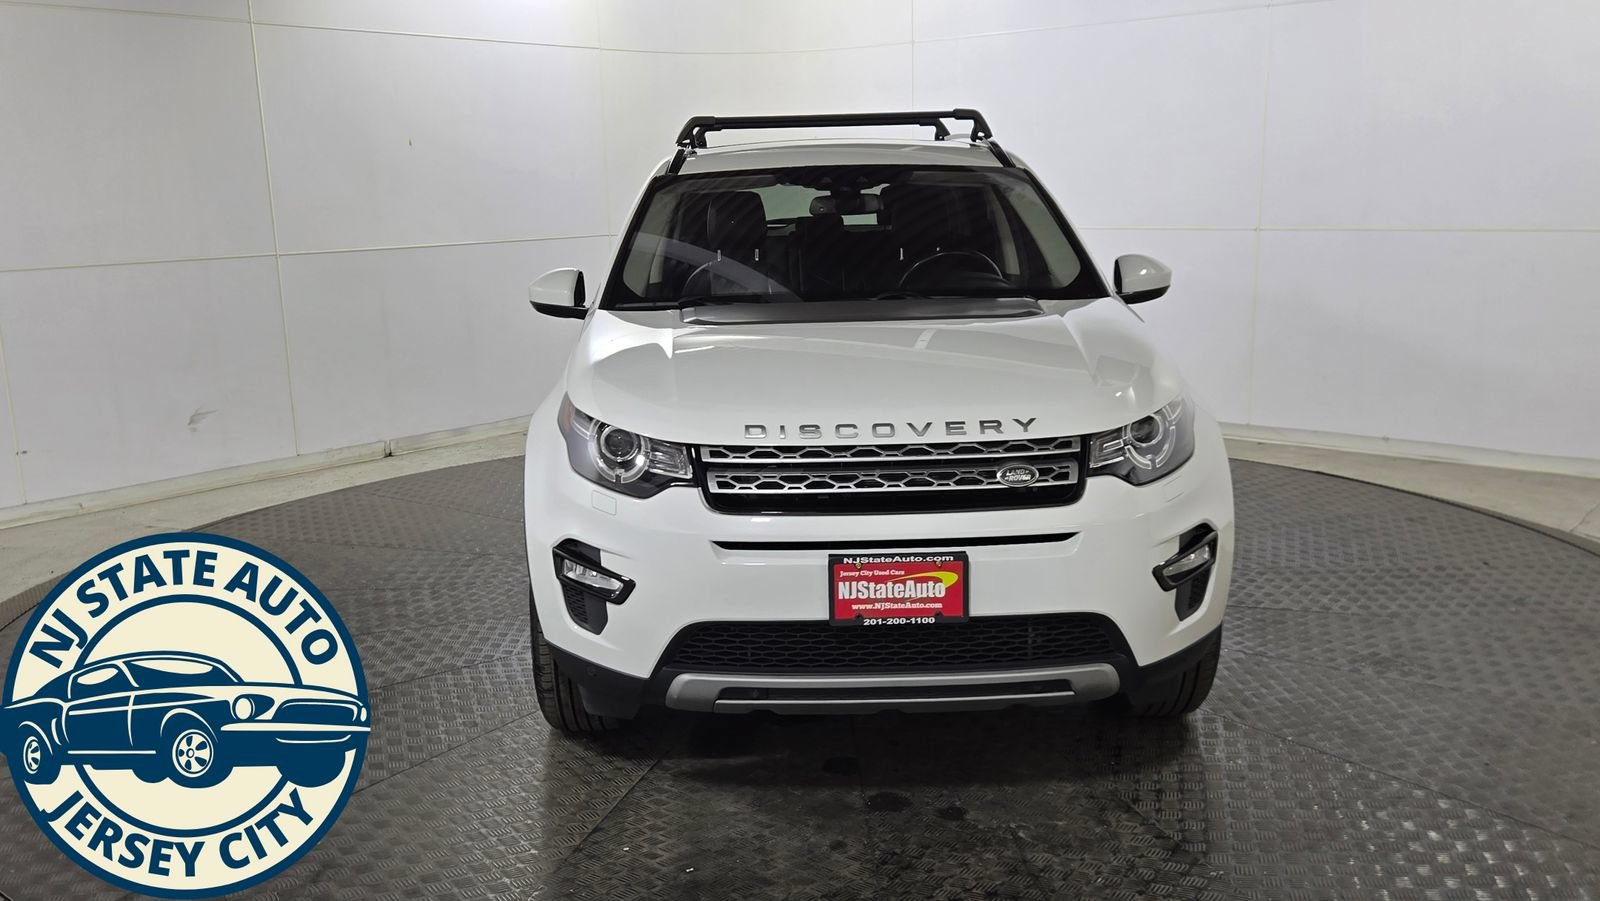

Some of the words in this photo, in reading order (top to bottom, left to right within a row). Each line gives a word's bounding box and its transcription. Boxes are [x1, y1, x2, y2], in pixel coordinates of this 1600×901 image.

[744, 417, 1037, 439] DISCOVERY
[843, 555, 954, 564] NJStateAuto.com
[838, 580, 946, 599] NJStateAuto
[851, 602, 943, 610] www.NJStateAuto.com
[863, 617, 936, 626] 201-200-1100
